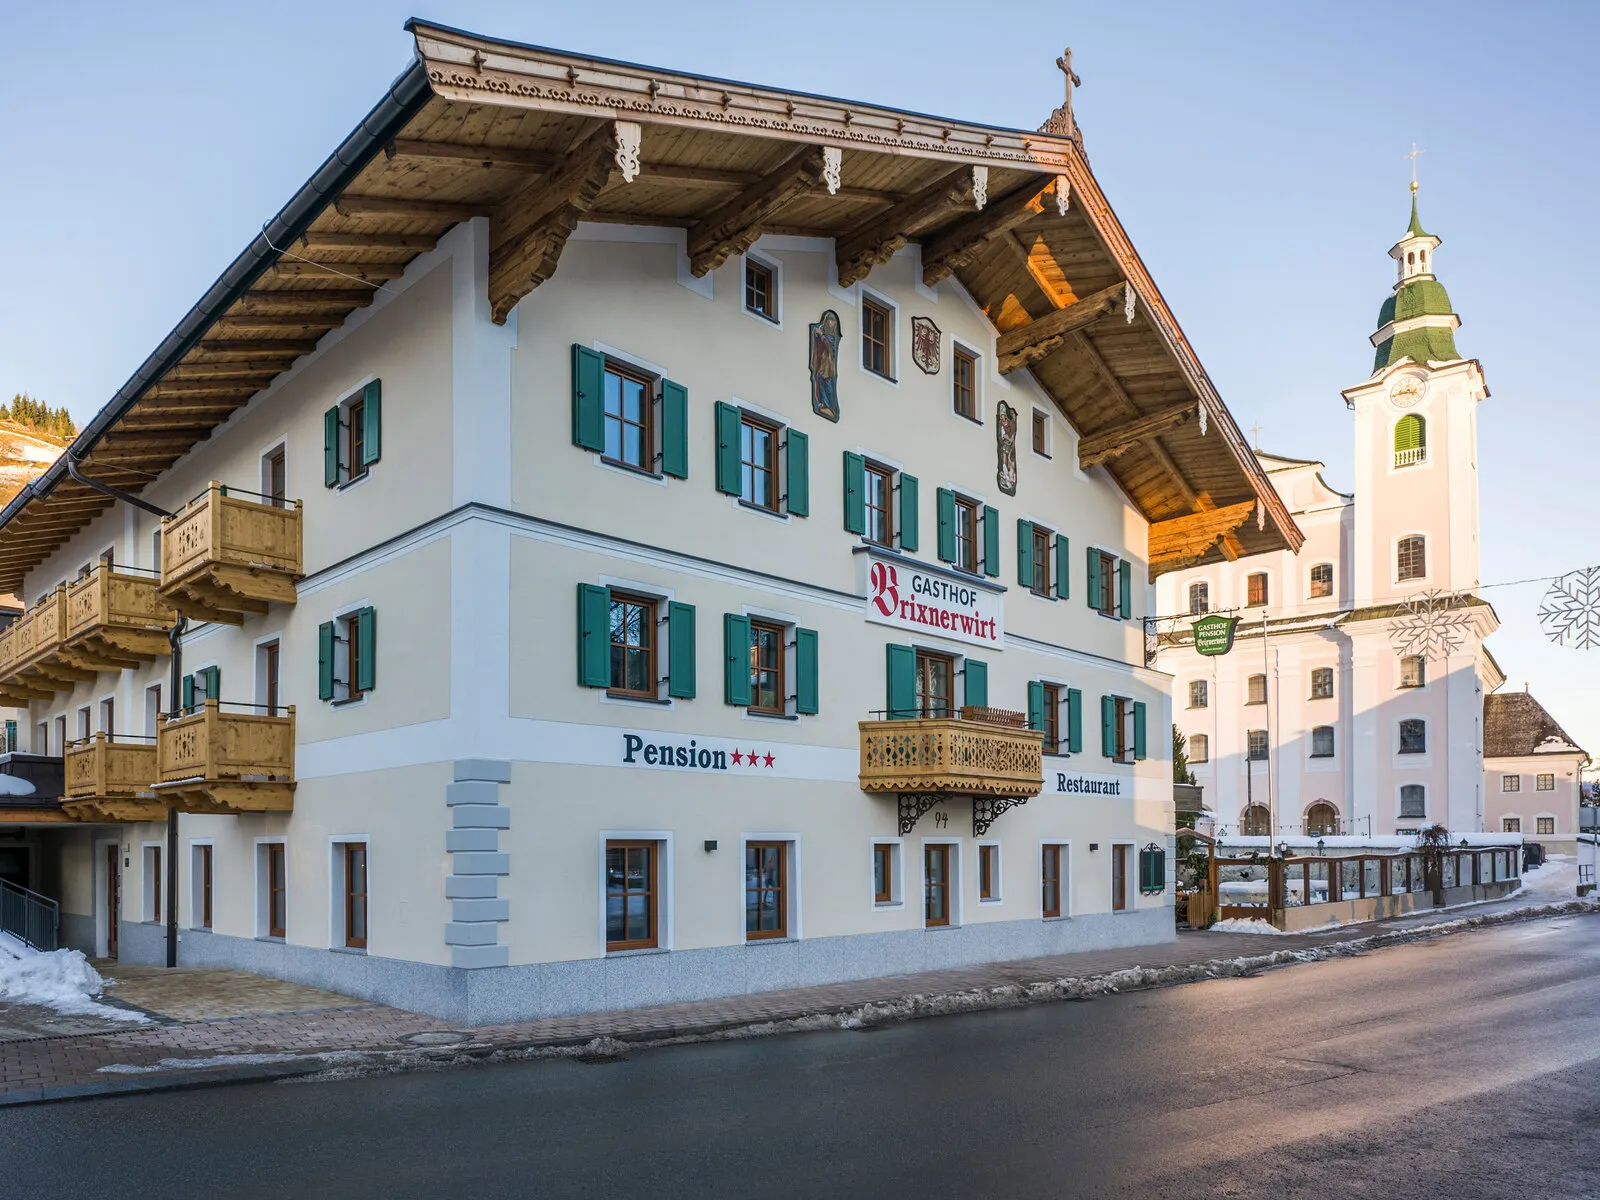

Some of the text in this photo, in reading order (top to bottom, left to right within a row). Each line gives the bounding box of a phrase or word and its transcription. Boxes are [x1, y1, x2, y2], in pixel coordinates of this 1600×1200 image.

[870, 562, 996, 641] Brixnerwirt
[912, 575, 976, 607] GASTHOF
[1198, 622, 1227, 632] GASTHOF
[1199, 630, 1226, 638] PENSION
[623, 734, 727, 770] Pension
[1057, 773, 1120, 795] Restaurant
[935, 811, 948, 828] 94
